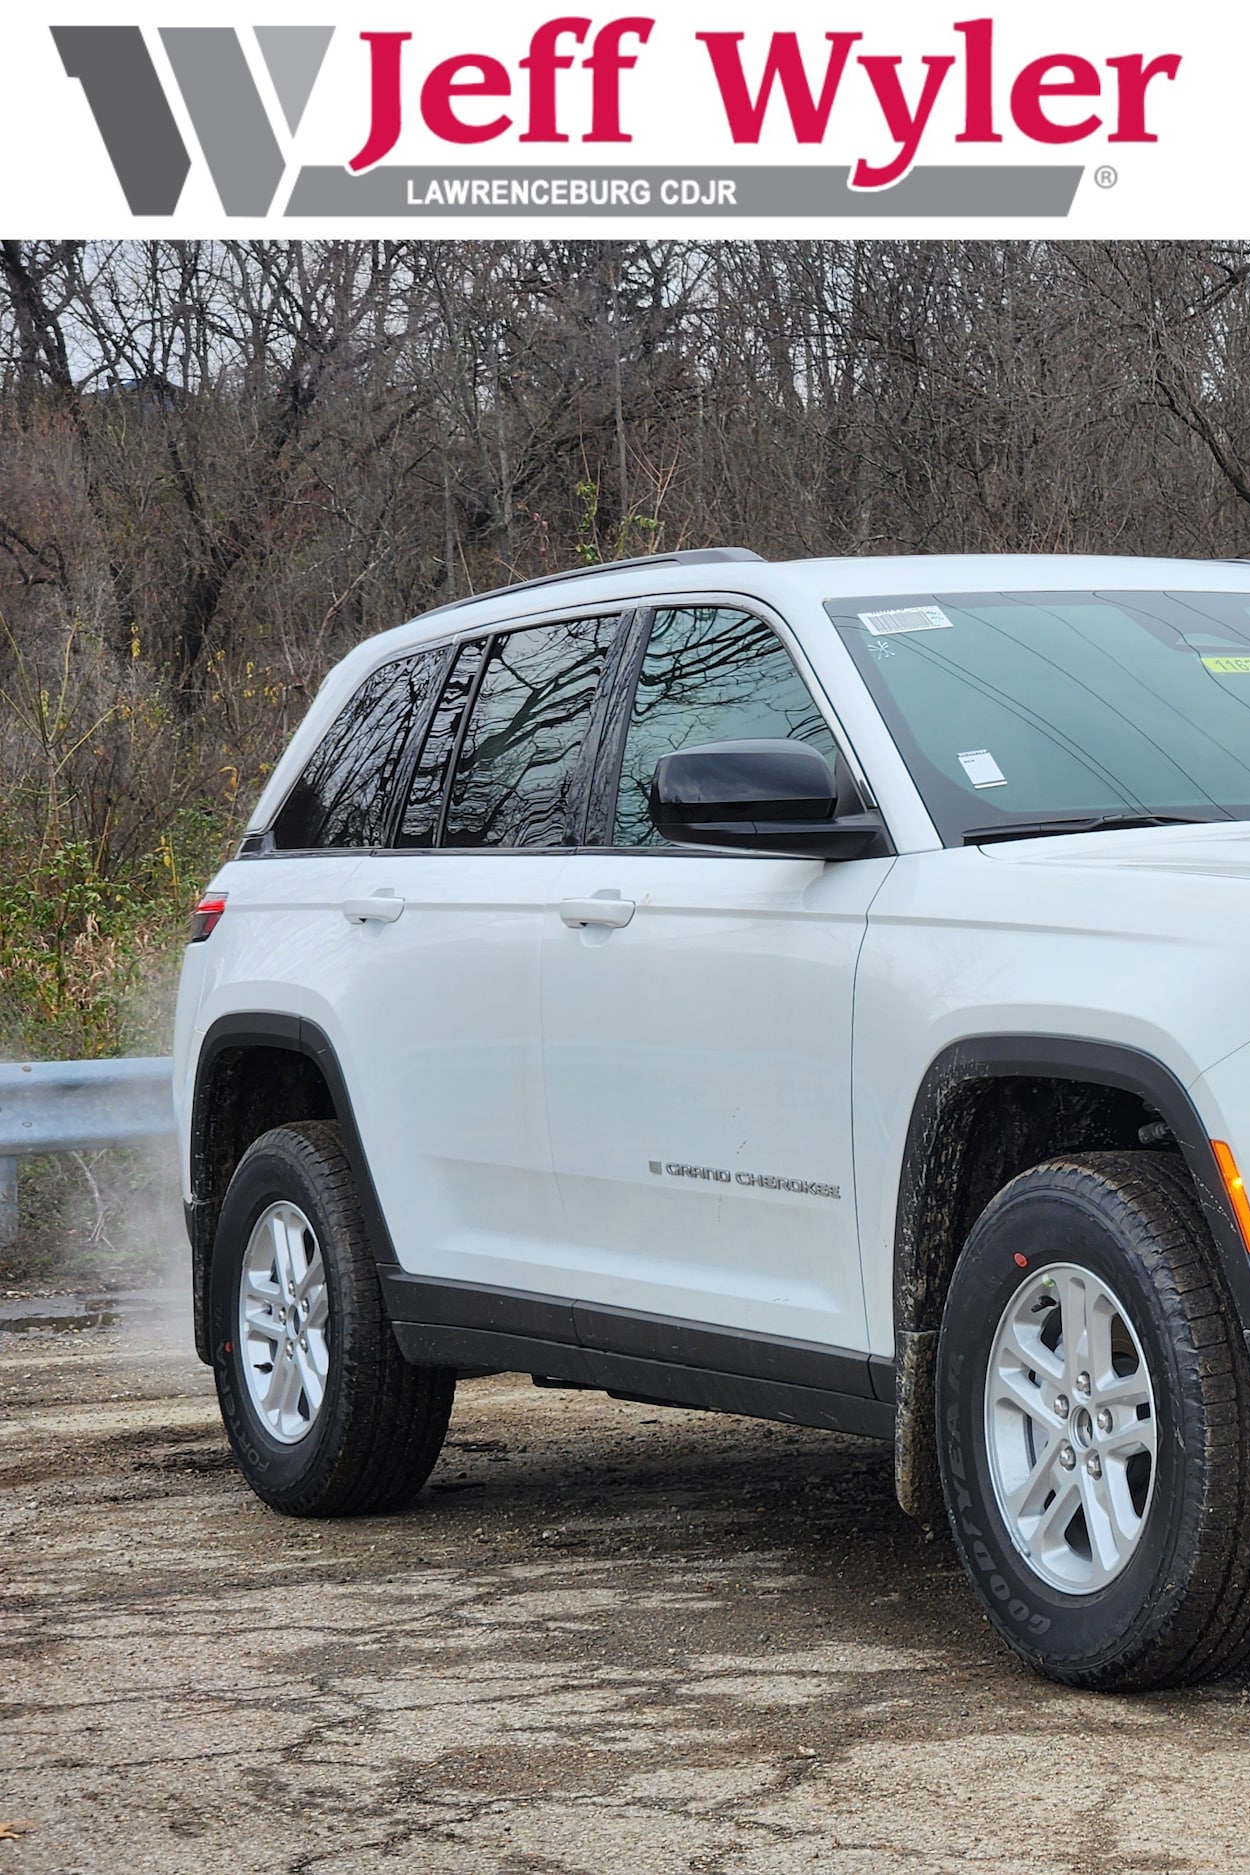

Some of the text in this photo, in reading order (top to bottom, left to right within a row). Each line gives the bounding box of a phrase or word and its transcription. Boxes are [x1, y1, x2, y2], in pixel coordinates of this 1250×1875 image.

[665, 1161, 841, 1199] GRAND CHEROKEE
[216, 1341, 271, 1473] FORTERA
[947, 1352, 1051, 1635] GOODYEAR
